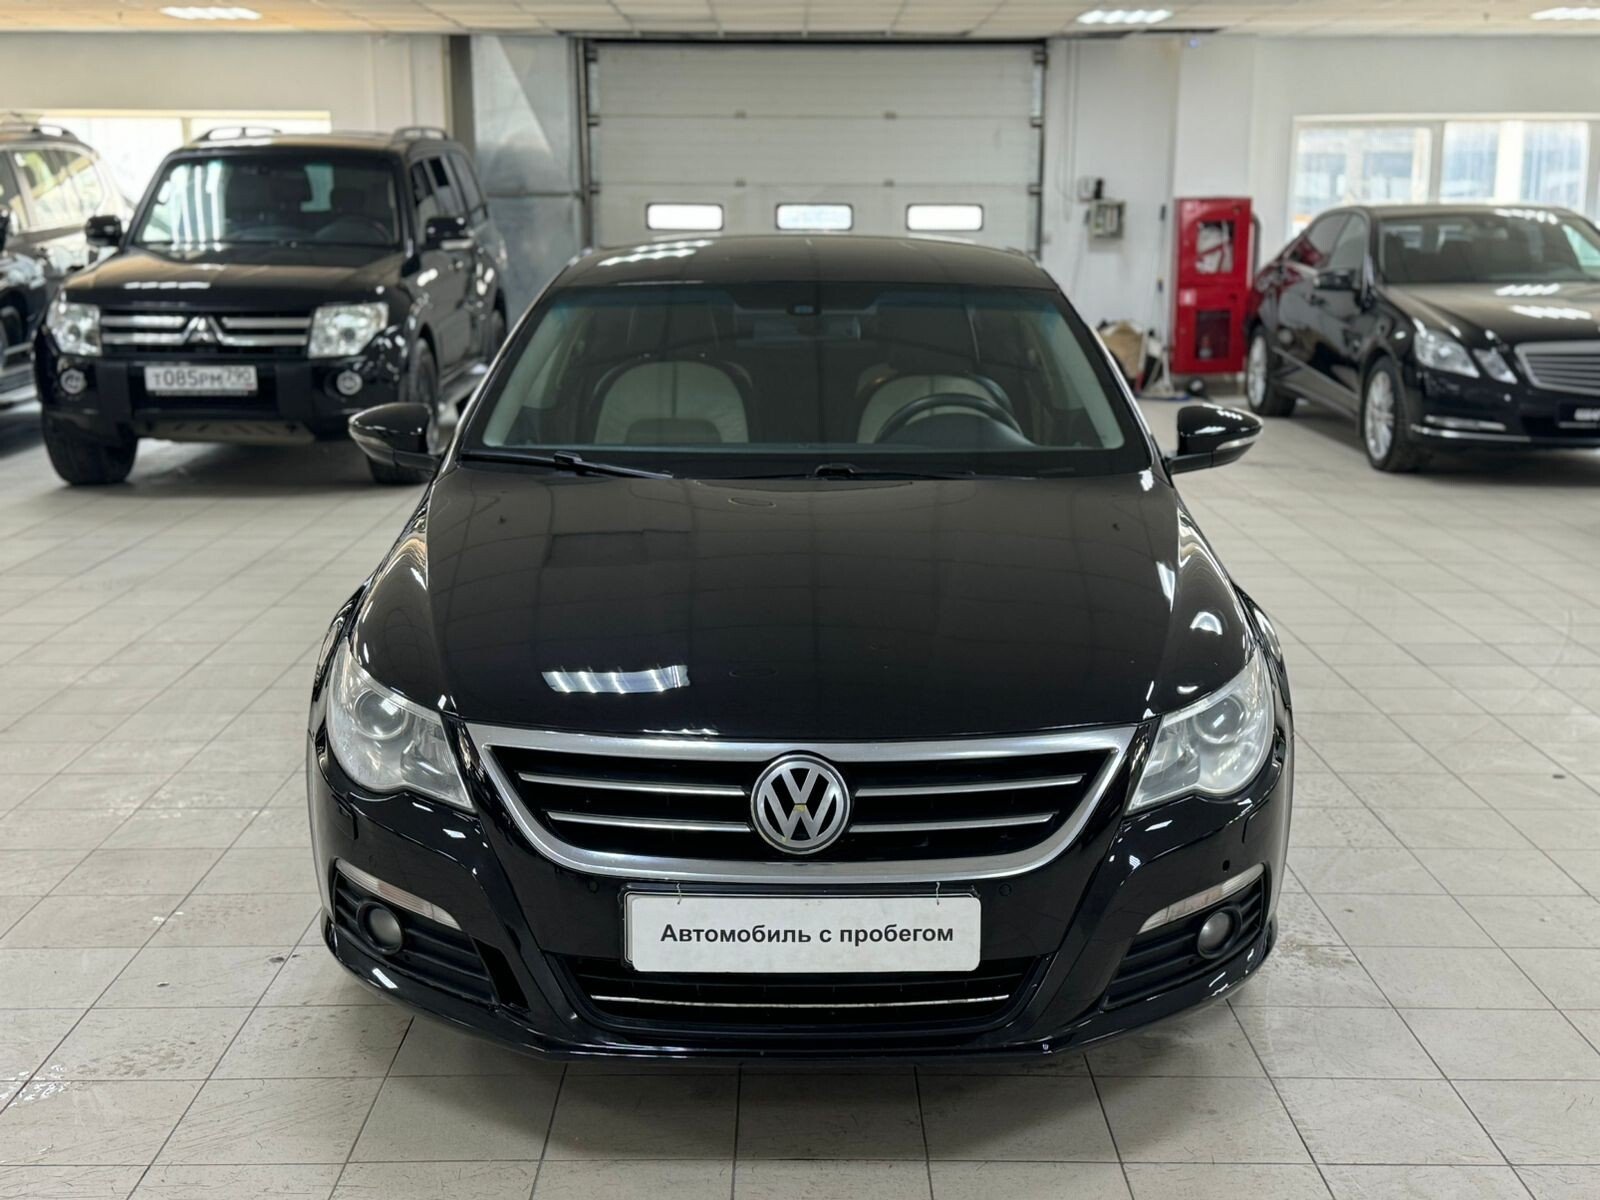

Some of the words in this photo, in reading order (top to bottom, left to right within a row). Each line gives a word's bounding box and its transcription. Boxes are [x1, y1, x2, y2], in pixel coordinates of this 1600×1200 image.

[660, 923, 812, 943] Автомобиль
[819, 928, 832, 942] с
[839, 923, 954, 947] пробегом
